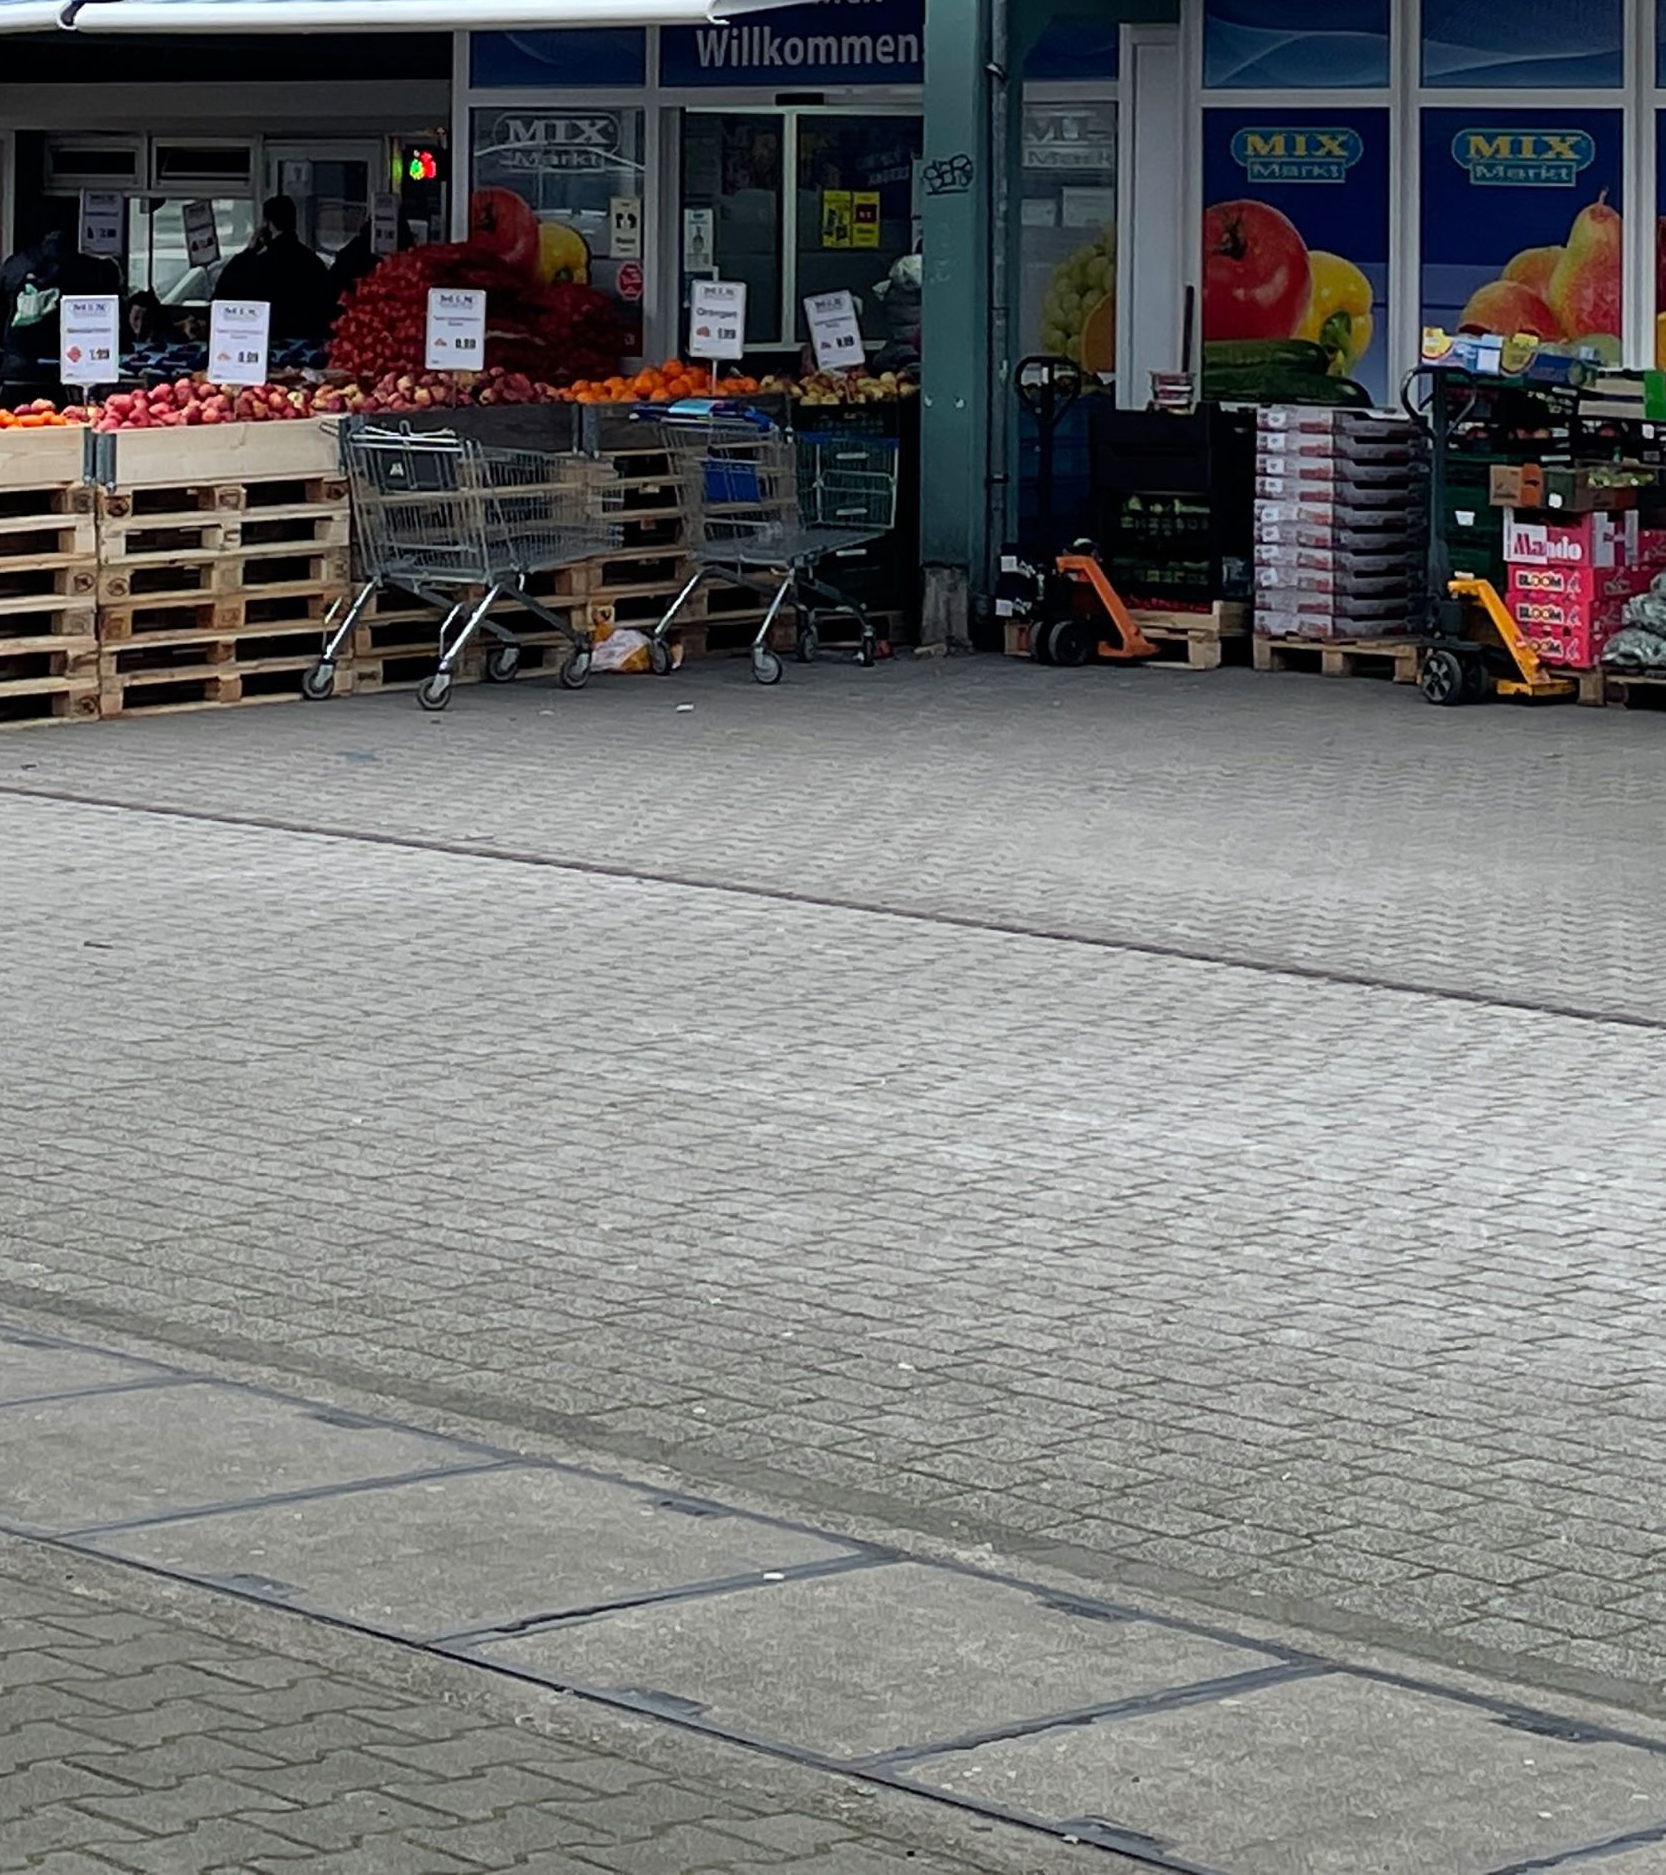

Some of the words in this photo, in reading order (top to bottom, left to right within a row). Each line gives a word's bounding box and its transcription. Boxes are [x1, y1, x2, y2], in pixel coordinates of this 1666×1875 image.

[696, 26, 918, 67] Willkommen
[504, 119, 611, 145] MIX
[1245, 133, 1350, 156] MIX
[1465, 135, 1582, 159] MIX
[1513, 530, 1583, 562] Mando
[1518, 570, 1564, 589] BLOOM
[1519, 603, 1563, 621] BLOOM
